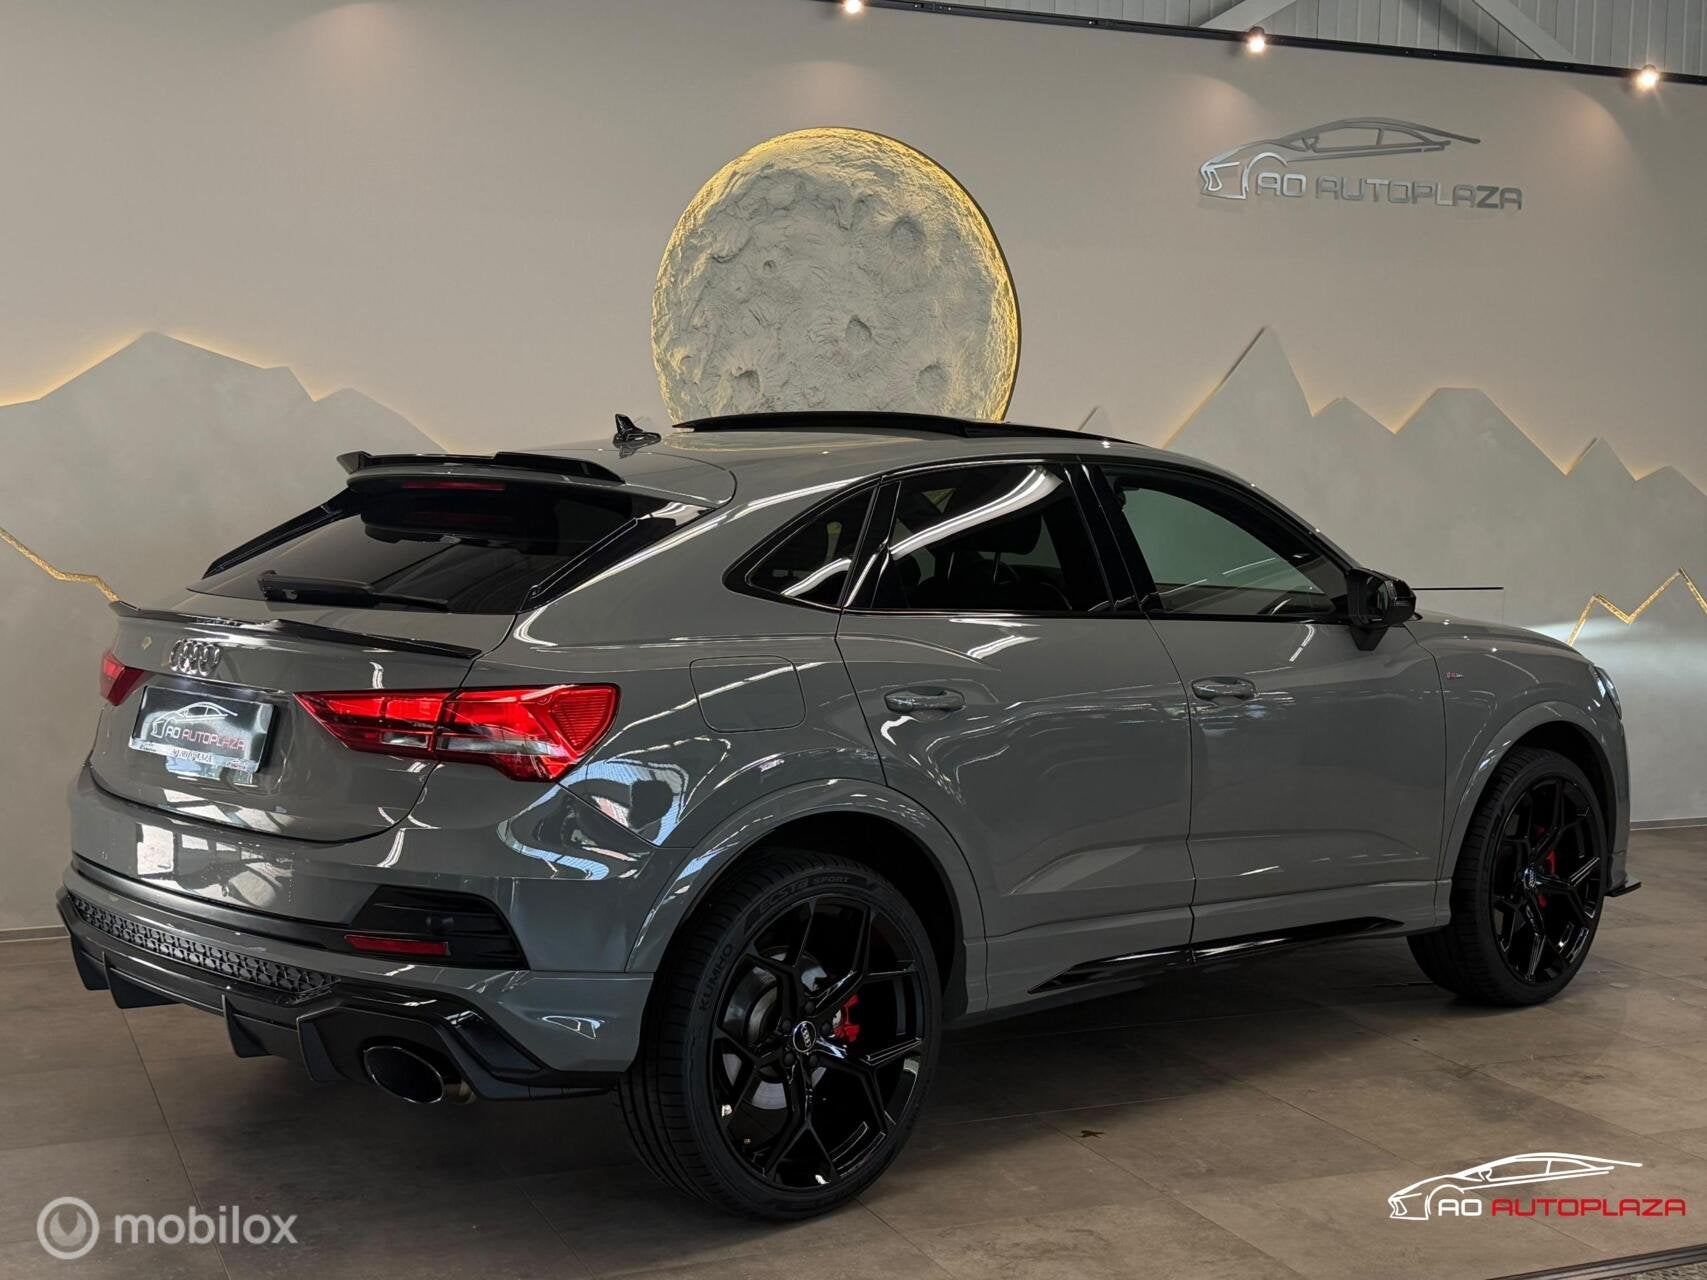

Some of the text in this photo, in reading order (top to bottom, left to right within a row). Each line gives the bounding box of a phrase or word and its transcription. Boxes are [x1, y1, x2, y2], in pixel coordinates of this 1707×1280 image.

[1256, 172, 1523, 210] AO AUTOPLAZA
[164, 725, 246, 750] AO AUTOPLAZA
[813, 875, 850, 885] SPORT
[698, 943, 733, 1011] KUMHO
